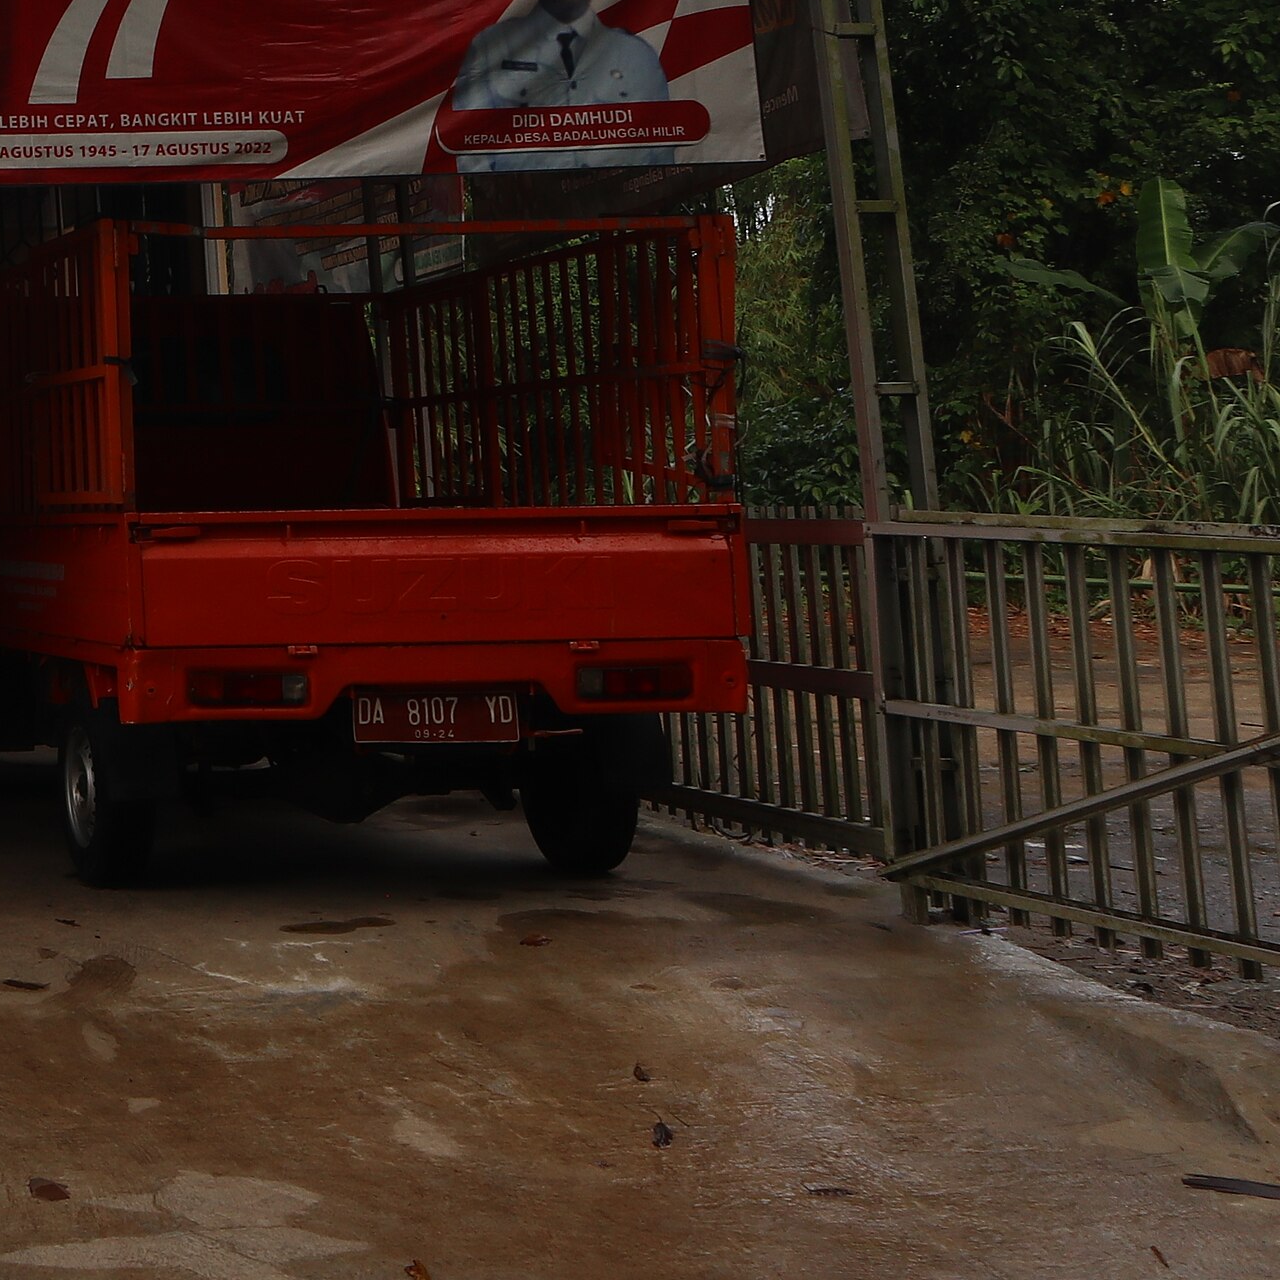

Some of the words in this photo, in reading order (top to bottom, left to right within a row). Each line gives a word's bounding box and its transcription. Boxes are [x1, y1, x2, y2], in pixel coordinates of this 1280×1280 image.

[54, 114, 116, 131] CEPAT,
[120, 112, 198, 128] BANGKIT
[204, 111, 253, 126] LEBIH
[258, 110, 305, 124] KUAT
[512, 114, 545, 129] DIDI
[549, 109, 633, 127] DAMHUDI
[463, 134, 511, 145] KEPALA
[514, 132, 548, 143] DESA
[550, 129, 649, 142] BADALUNGGAI
[653, 126, 686, 137] HILIR
[0, 146, 73, 159] AGUSTUS
[78, 145, 118, 158] 1945
[132, 144, 150, 157] 17
[155, 143, 229, 157] AGUSTUS
[234, 141, 272, 155] 2022
[266, 556, 613, 615] SUZUKI
[358, 697, 385, 725] DA
[406, 697, 459, 724] 8107
[485, 696, 514, 724] YD
